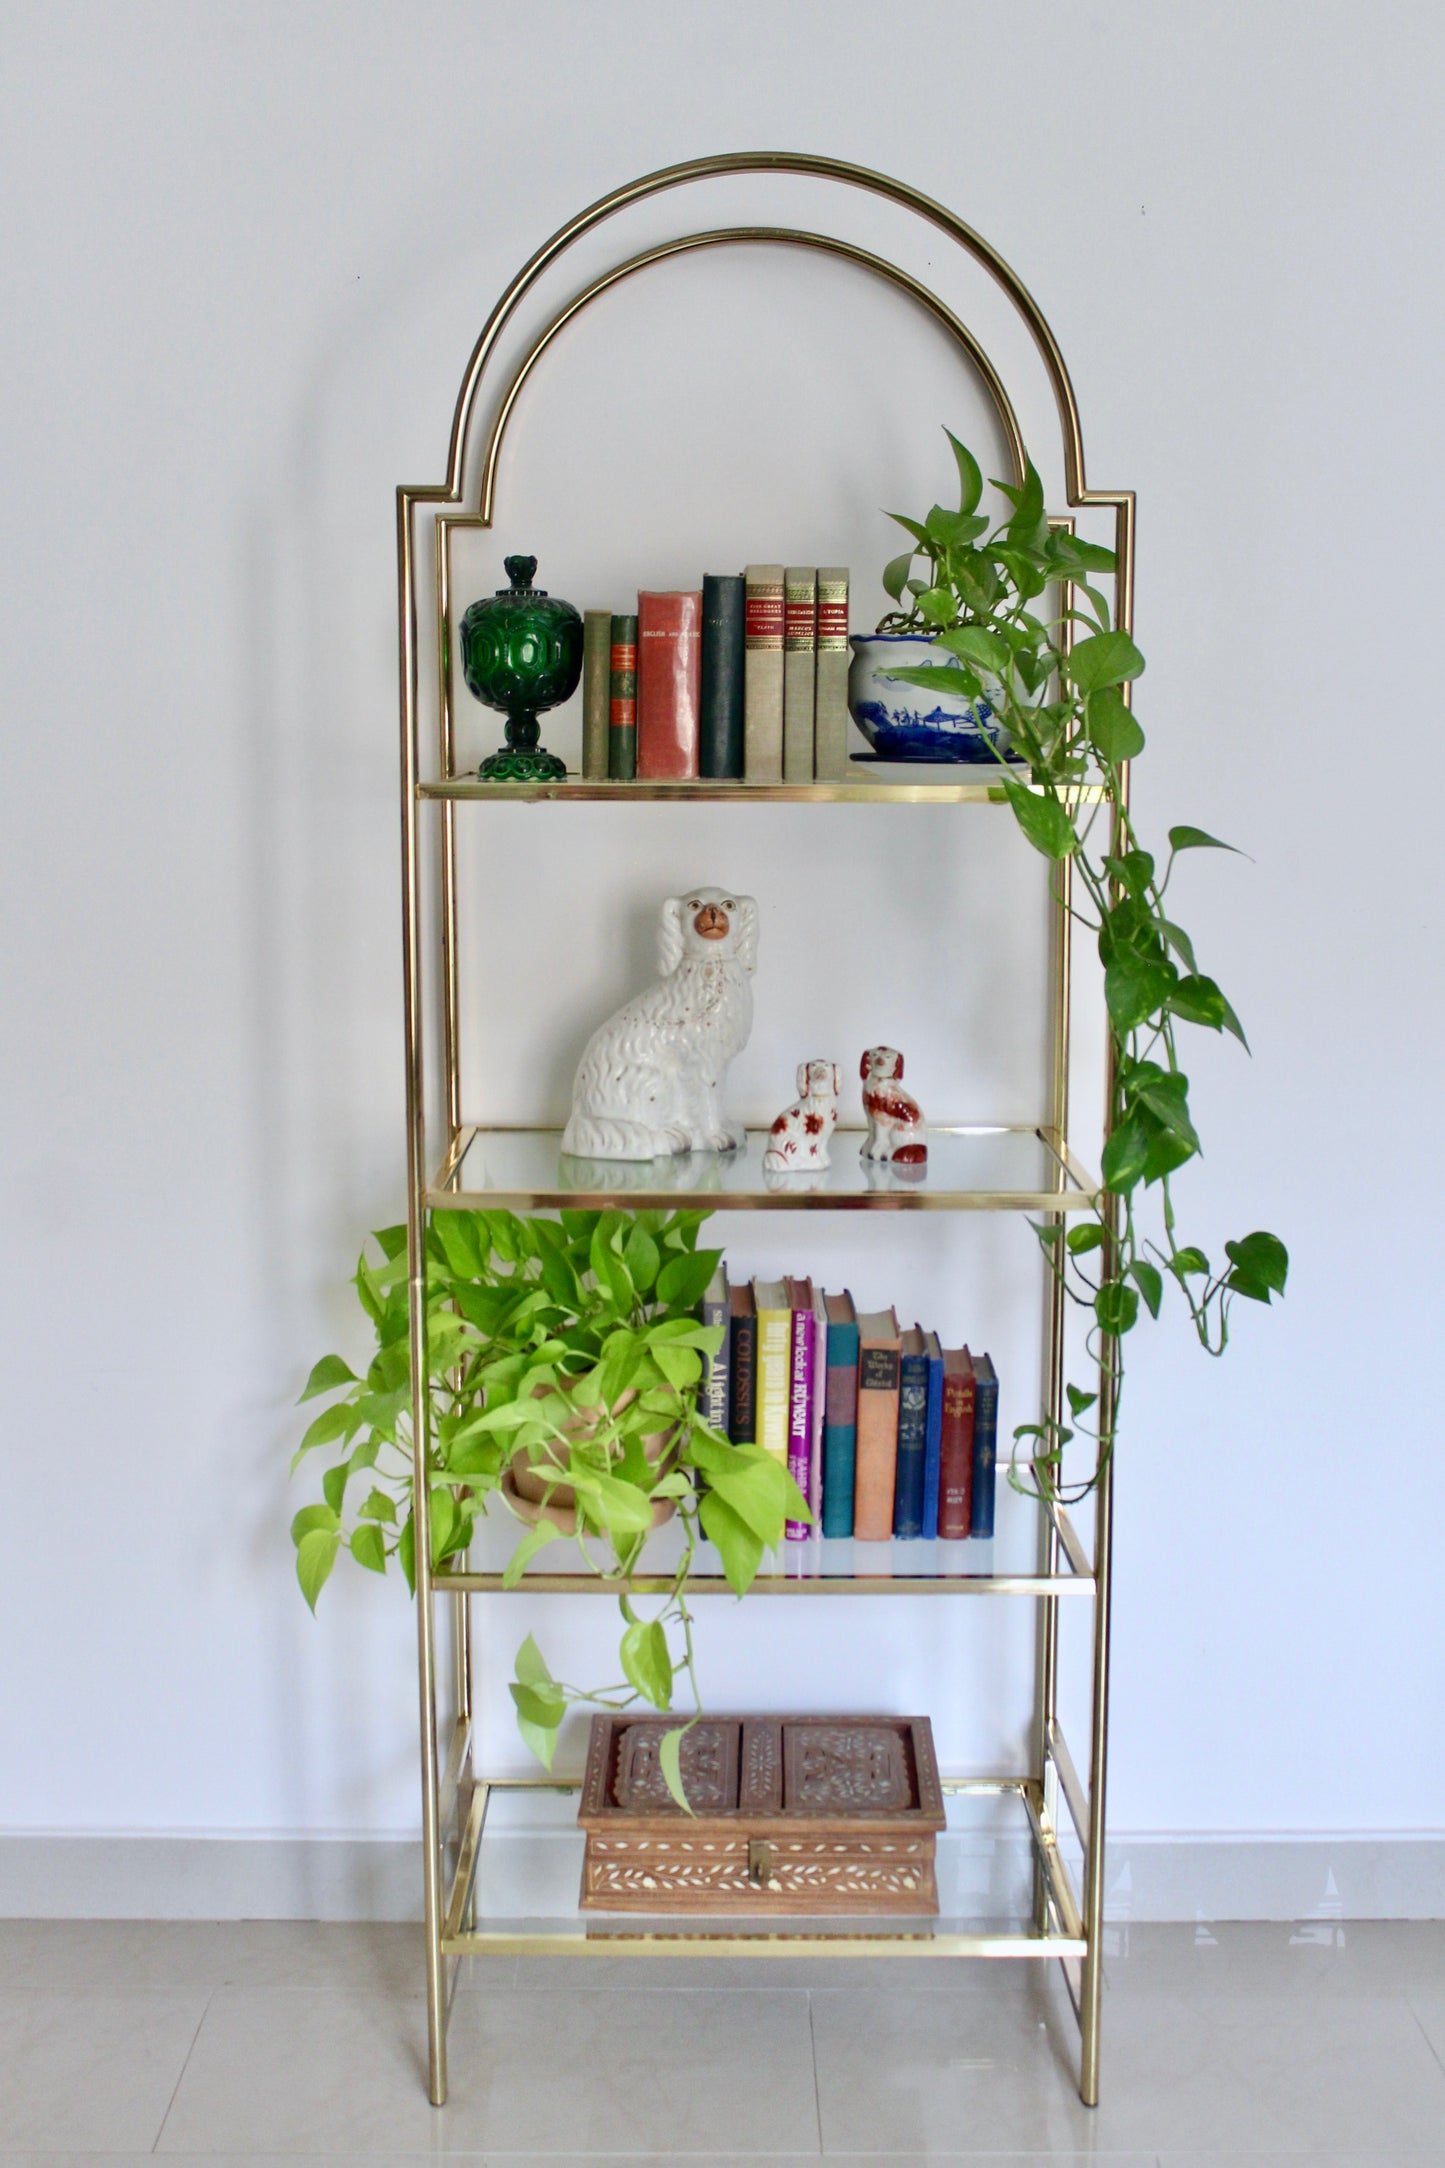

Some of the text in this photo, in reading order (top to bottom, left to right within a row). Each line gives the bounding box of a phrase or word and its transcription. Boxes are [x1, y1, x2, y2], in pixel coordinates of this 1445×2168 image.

[796, 1312, 807, 1321] a
[796, 1322, 806, 1346] new
[795, 1346, 809, 1370] look
[735, 1329, 752, 1425] COLOSSUS
[791, 1383, 808, 1439] KUWAIT
